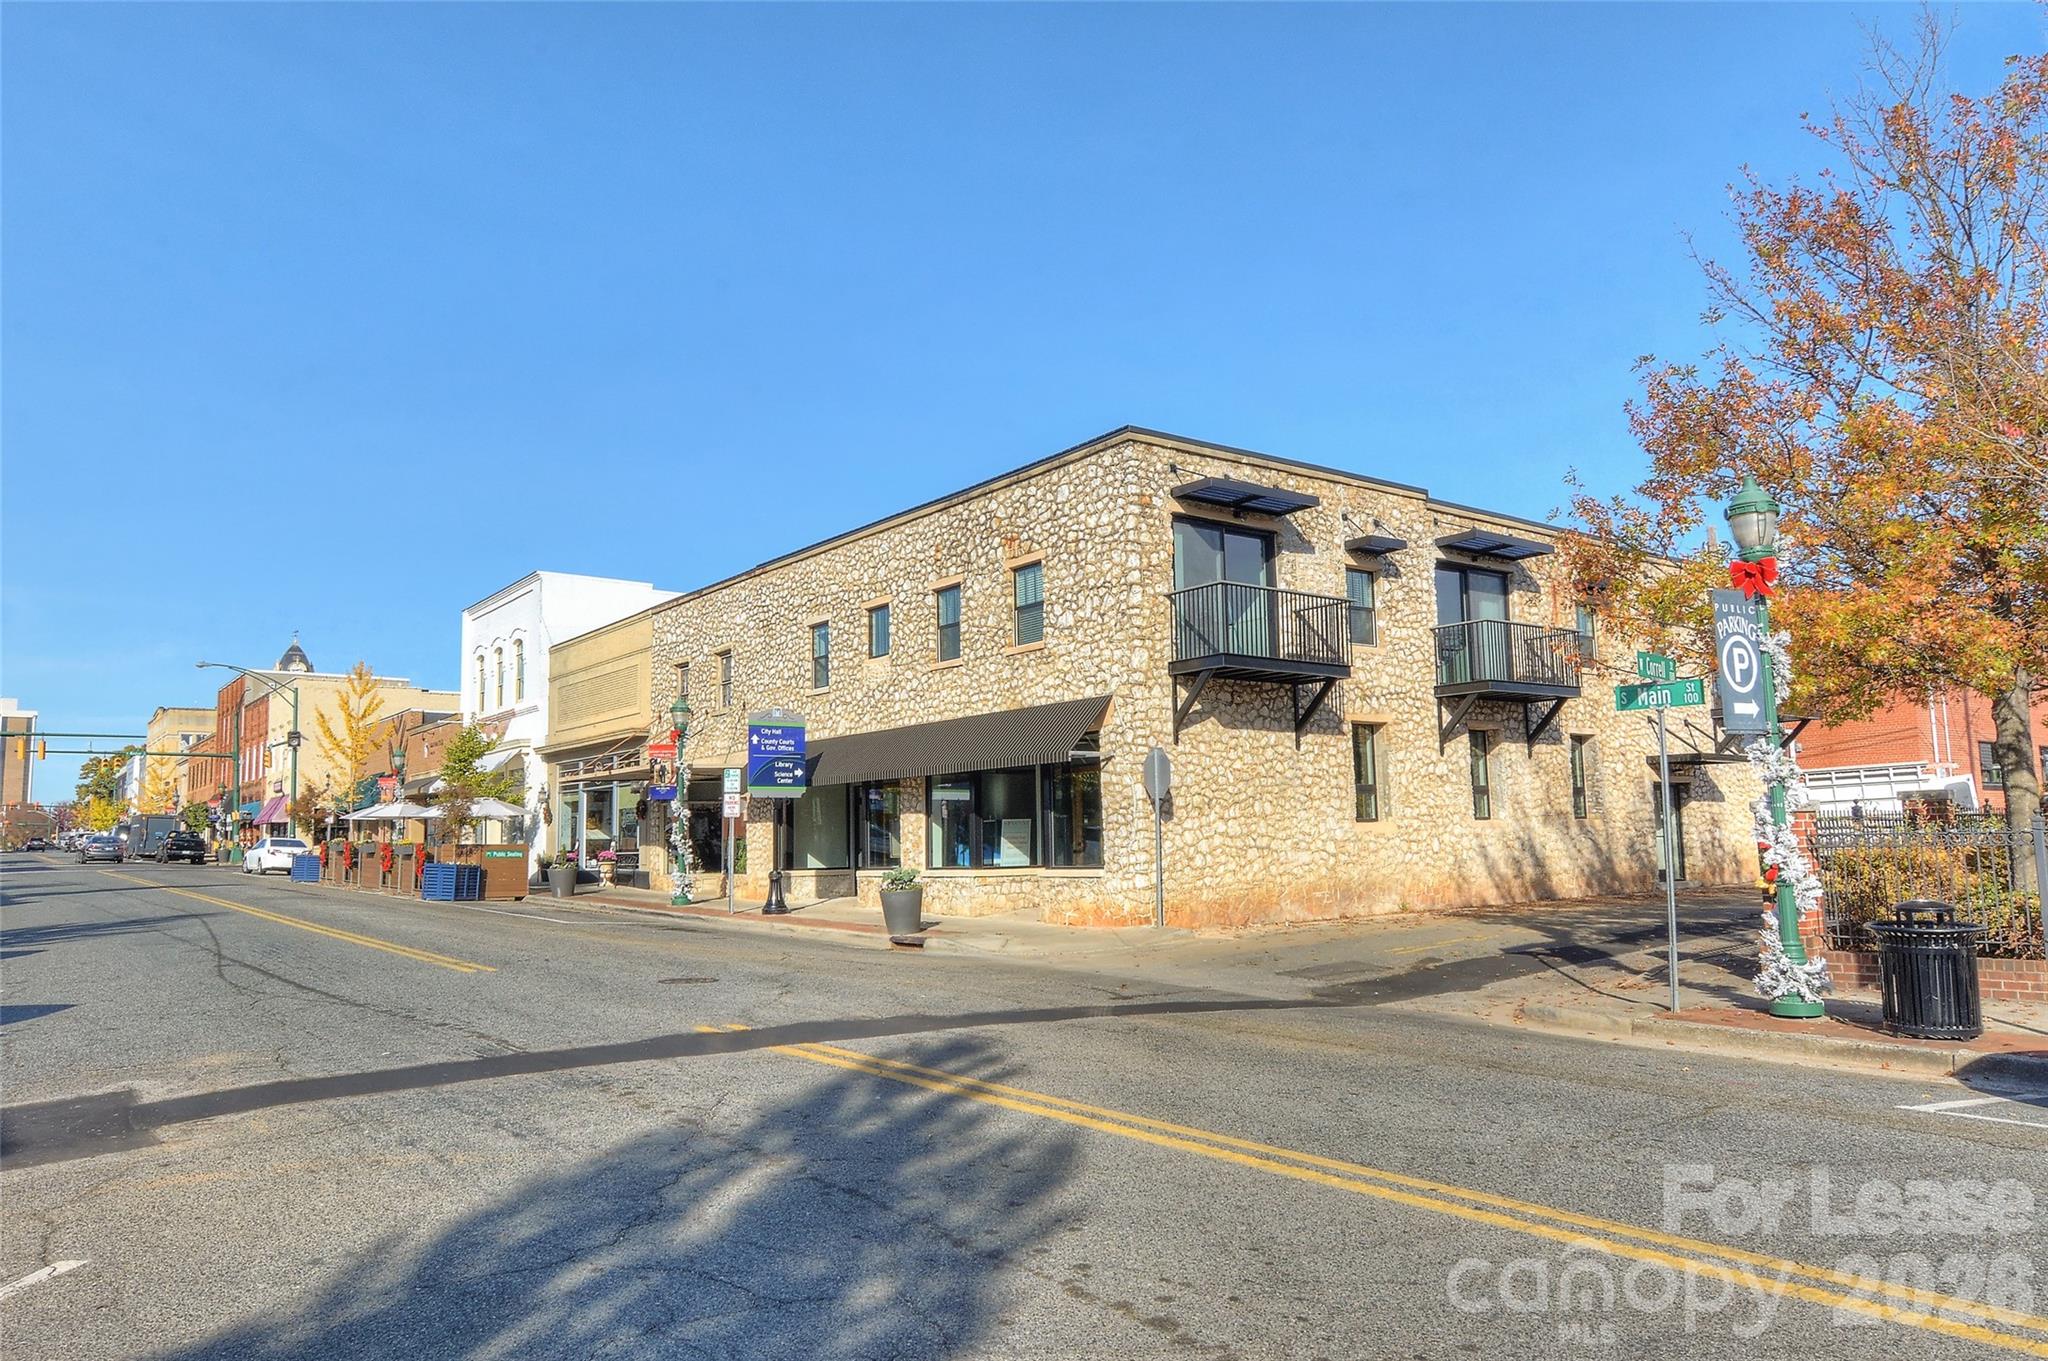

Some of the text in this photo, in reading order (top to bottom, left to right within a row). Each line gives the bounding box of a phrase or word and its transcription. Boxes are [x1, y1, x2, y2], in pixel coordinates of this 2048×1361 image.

[1715, 603, 1756, 614] PUBLIC
[1716, 616, 1758, 641] PARKING
[1733, 647, 1749, 682] P
[1620, 682, 1696, 706] S Main St
[1684, 692, 1699, 703] 100
[761, 738, 778, 746] County
[774, 761, 793, 769] Library
